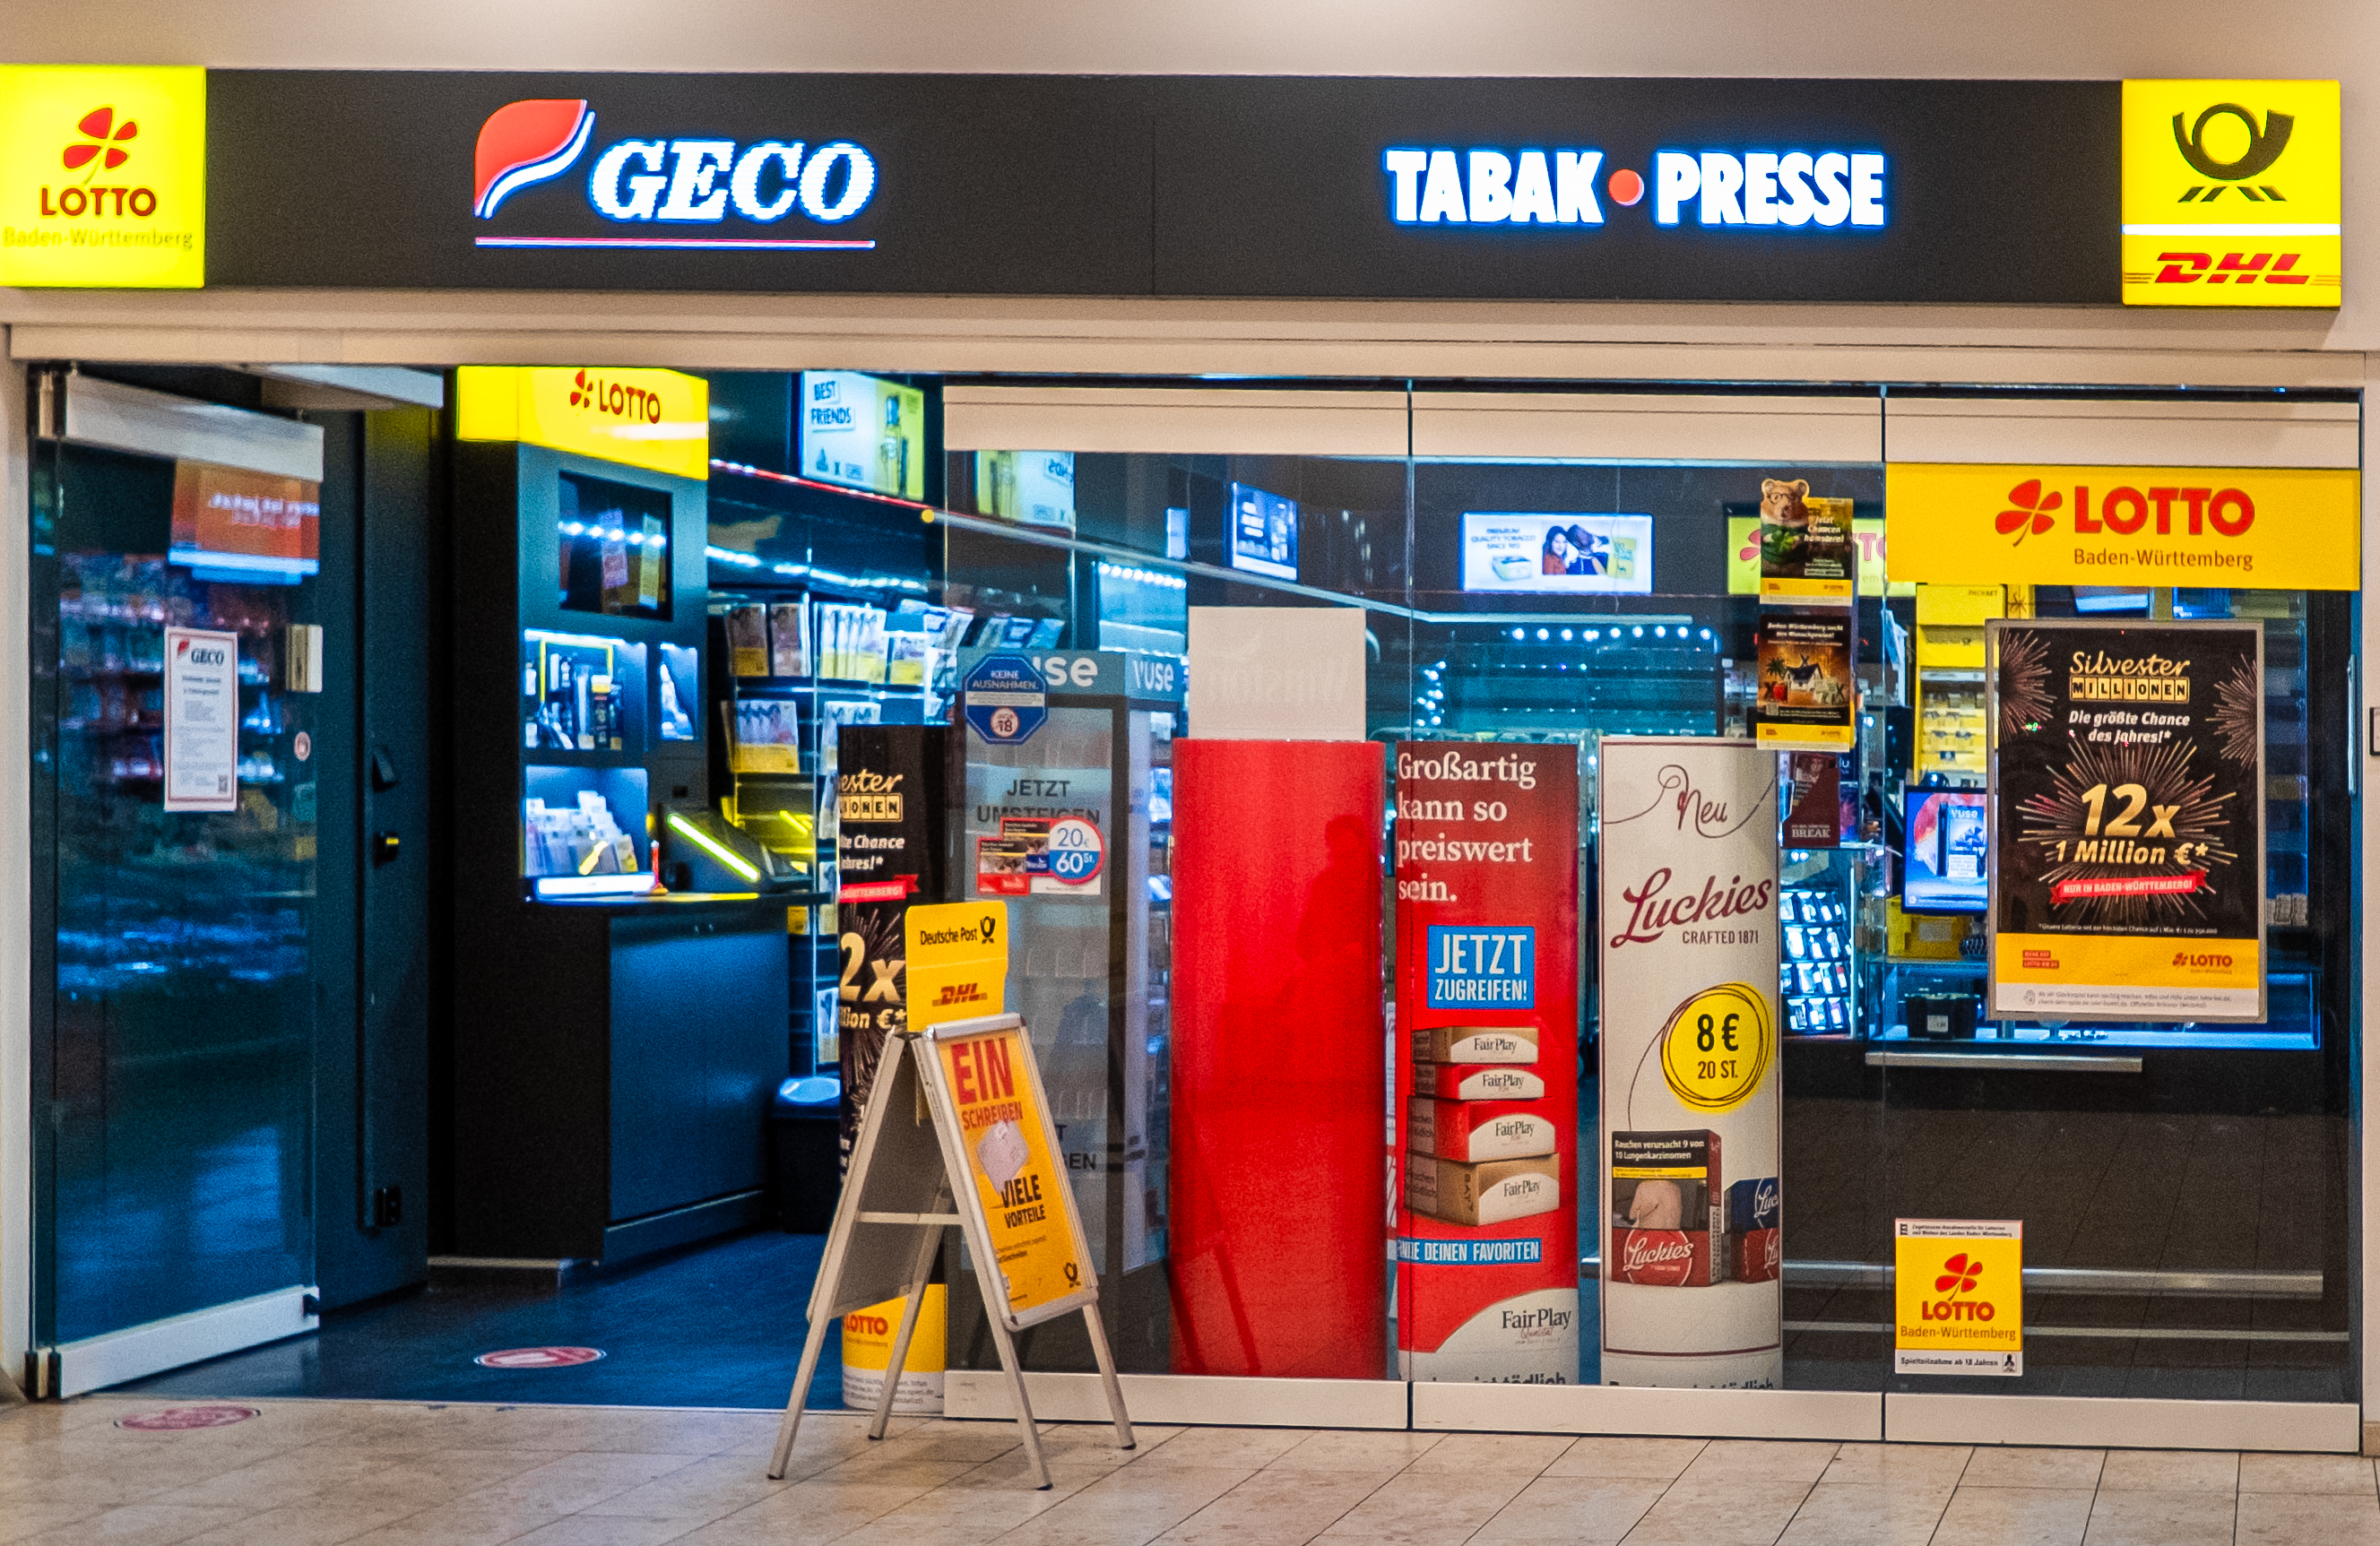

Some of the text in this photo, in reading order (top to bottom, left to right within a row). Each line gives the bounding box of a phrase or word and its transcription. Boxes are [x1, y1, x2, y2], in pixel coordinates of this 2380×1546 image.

[590, 139, 877, 221] GECO
[1385, 149, 1884, 226] TABAK PRESSE
[41, 187, 157, 217] LOTTO
[2, 227, 194, 251] Baden-Württemberg
[2154, 252, 2310, 285] DHL
[598, 379, 662, 424] LOTTO
[814, 380, 836, 402] BEST
[810, 407, 852, 426] FRIENDS
[2074, 486, 2255, 536] LOTTO
[2073, 548, 2255, 571] Baden-Württemberg
[191, 648, 225, 667] GECO
[2069, 651, 2191, 677] Silvester
[972, 679, 1039, 689] AUSNAHMEN.
[990, 669, 1020, 679] KEINE
[2072, 681, 2186, 696] MILLIONEN
[996, 720, 1014, 732] 18
[2069, 711, 2191, 728] Die größte Chance
[2088, 729, 2112, 743] des
[1398, 750, 1537, 790] Großartig
[1007, 779, 1072, 798] JETZT
[1397, 790, 1509, 823] kann so
[2081, 782, 2181, 838] 12x
[853, 834, 905, 850] Chance
[1792, 828, 1831, 838] BREAK
[1397, 832, 1534, 868] preiswert
[2055, 840, 2067, 862] 1
[2073, 840, 2166, 865] Million
[1398, 872, 1458, 903] sein.
[2064, 884, 2081, 894] NUR
[2083, 883, 2093, 893] IN
[1610, 867, 1773, 948] Luckies
[920, 926, 978, 946] Deutsche Post
[1682, 929, 1760, 945] CRAFTED 1871
[1434, 934, 1528, 975] JETZT
[2190, 954, 2233, 967] LOTTO
[940, 982, 980, 1006] DHL
[1434, 979, 1528, 1002] ZUGREIFEN!
[1697, 1013, 1740, 1052] 8 €
[950, 1037, 1015, 1105] EIN
[1697, 1059, 1739, 1080] 20 ST.
[961, 1101, 1024, 1130] SCHREIBEN
[1614, 1140, 1642, 1149] Rauchen
[1642, 1140, 1681, 1149] verursacht
[1683, 1139, 1689, 1148] 9
[1614, 1151, 1692, 1162] 10 Lungenkarzinomen
[1000, 1174, 1043, 1209] VIELE
[1004, 1204, 1046, 1229] VORTEILE
[1424, 1242, 1467, 1262] DEINEN
[1473, 1241, 1540, 1262] FAVORITEN
[1623, 1237, 1694, 1272] Luckies
[1922, 1301, 1995, 1322] LOTTO
[1900, 1325, 2016, 1342] Baden-Württemberg
